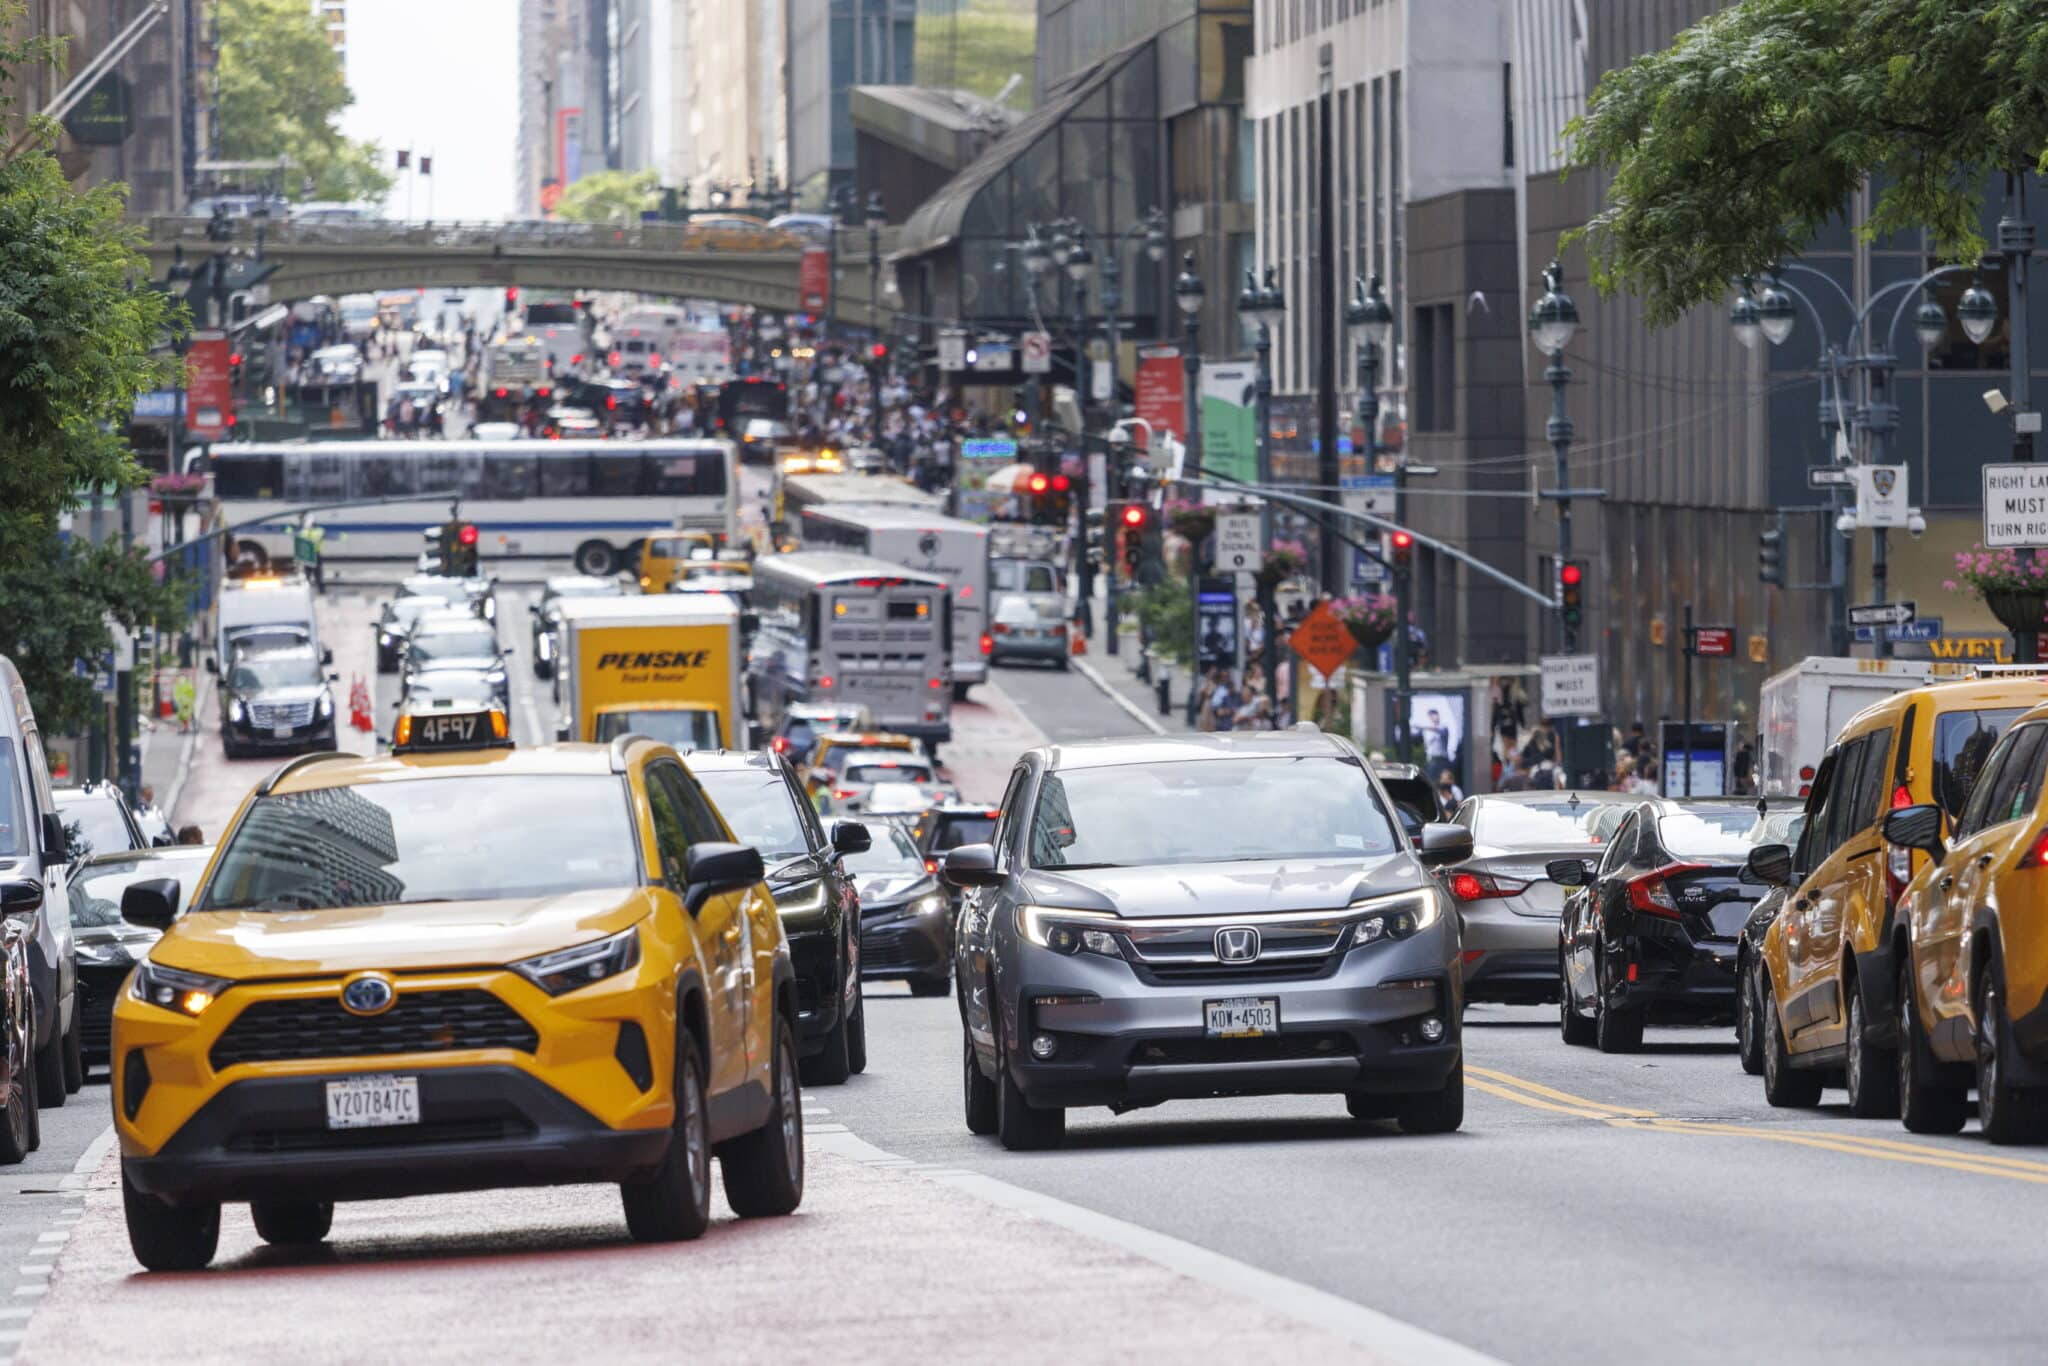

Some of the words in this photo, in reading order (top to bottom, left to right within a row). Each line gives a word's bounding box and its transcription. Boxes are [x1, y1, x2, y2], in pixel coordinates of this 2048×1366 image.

[1989, 476, 2025, 489] RIGHT
[2005, 499, 2045, 513] MUST
[1990, 524, 2022, 536] TURN
[596, 650, 711, 670] PENSKE
[1556, 679, 1584, 690] MUST
[423, 716, 478, 741] 4F97
[333, 1088, 412, 1117] Y207847C
